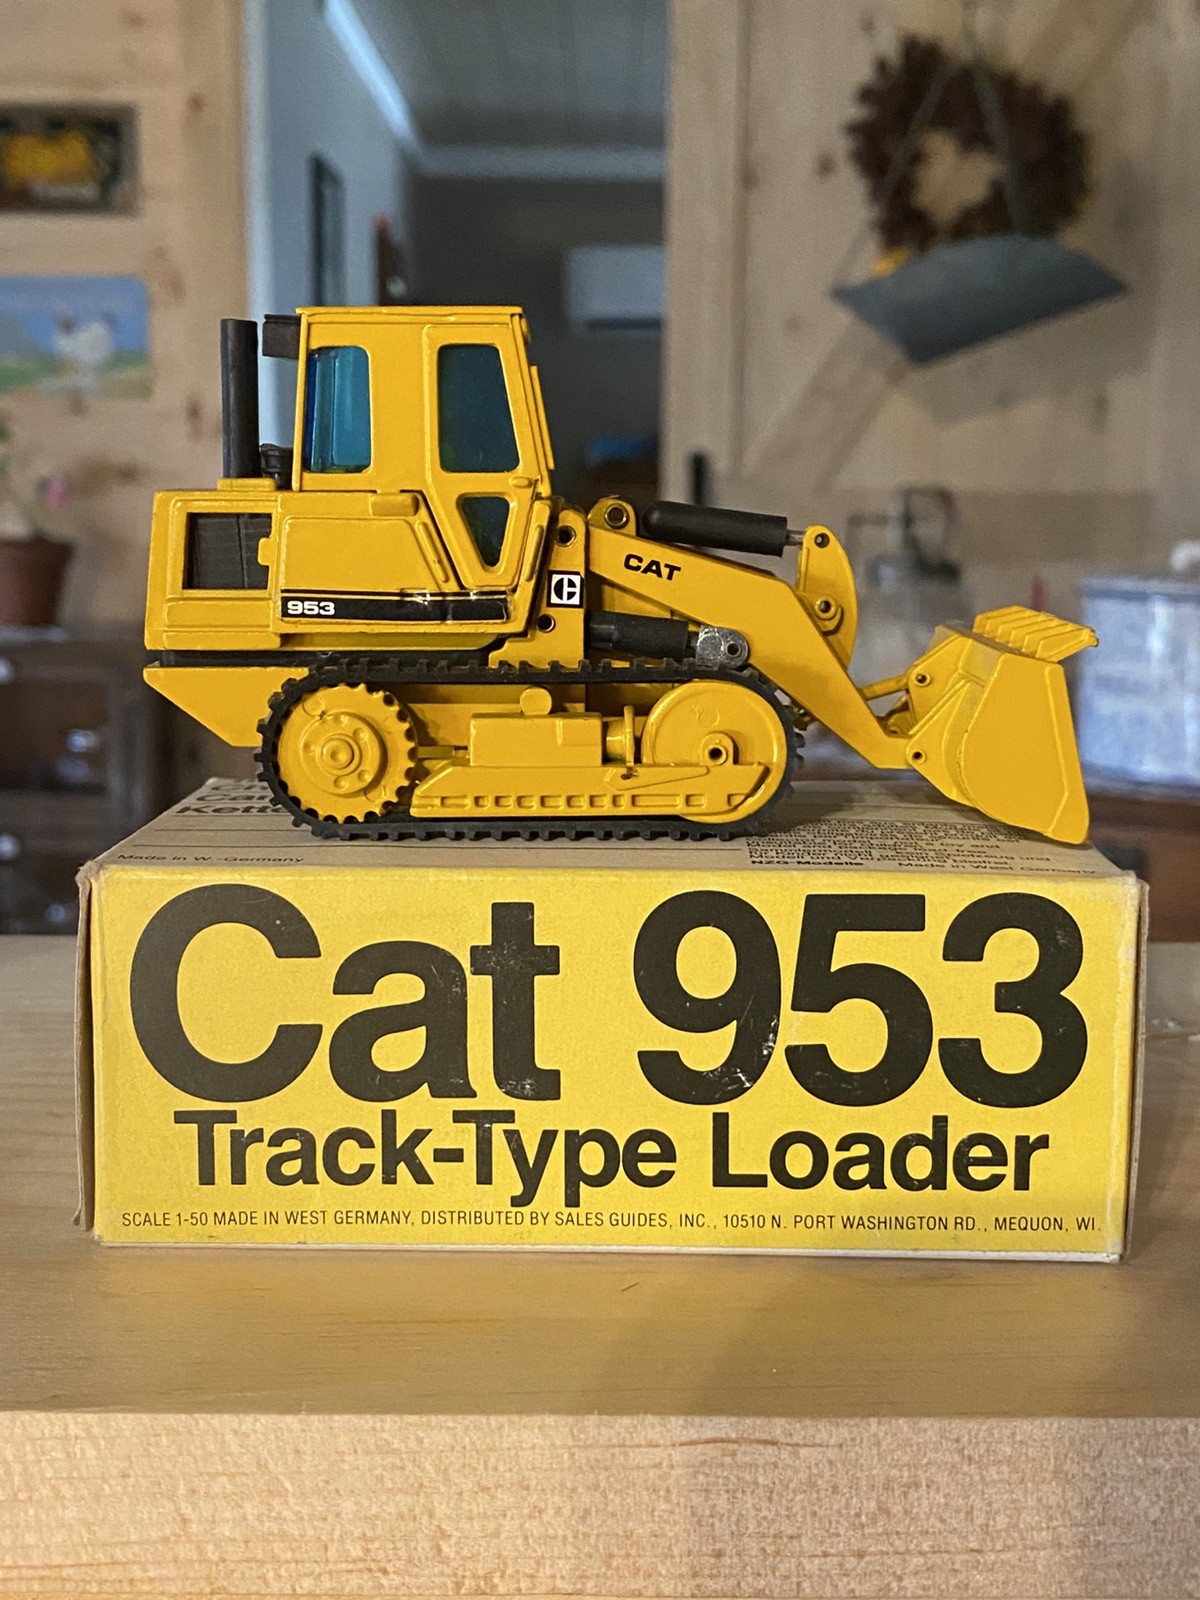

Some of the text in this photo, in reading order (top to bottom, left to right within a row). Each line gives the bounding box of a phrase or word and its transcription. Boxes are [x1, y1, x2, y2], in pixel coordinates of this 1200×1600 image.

[623, 553, 682, 581] CAT
[286, 601, 336, 617] 953
[130, 884, 1087, 1108] Cat 953
[173, 1110, 1050, 1208] Track-Type Loader
[122, 1212, 171, 1227] SCALE
[176, 1211, 208, 1227] 1-50
[213, 1211, 258, 1226] MADE
[264, 1210, 279, 1225] IN
[284, 1210, 328, 1225] WEST
[333, 1210, 415, 1227] GERMANY,
[421, 1210, 524, 1226] DISTRIBUTED
[530, 1211, 550, 1226] BY
[555, 1211, 604, 1227] SALES
[609, 1212, 673, 1229] GUIDES,
[724, 1214, 766, 1229] 10510
[771, 1214, 787, 1229] N.
[793, 1214, 836, 1230] PORT
[841, 1215, 948, 1231] WASHINGTON
[954, 1216, 988, 1233] RD.,
[994, 1216, 1069, 1233] MEQUON,
[1075, 1216, 1102, 1231] WI.
